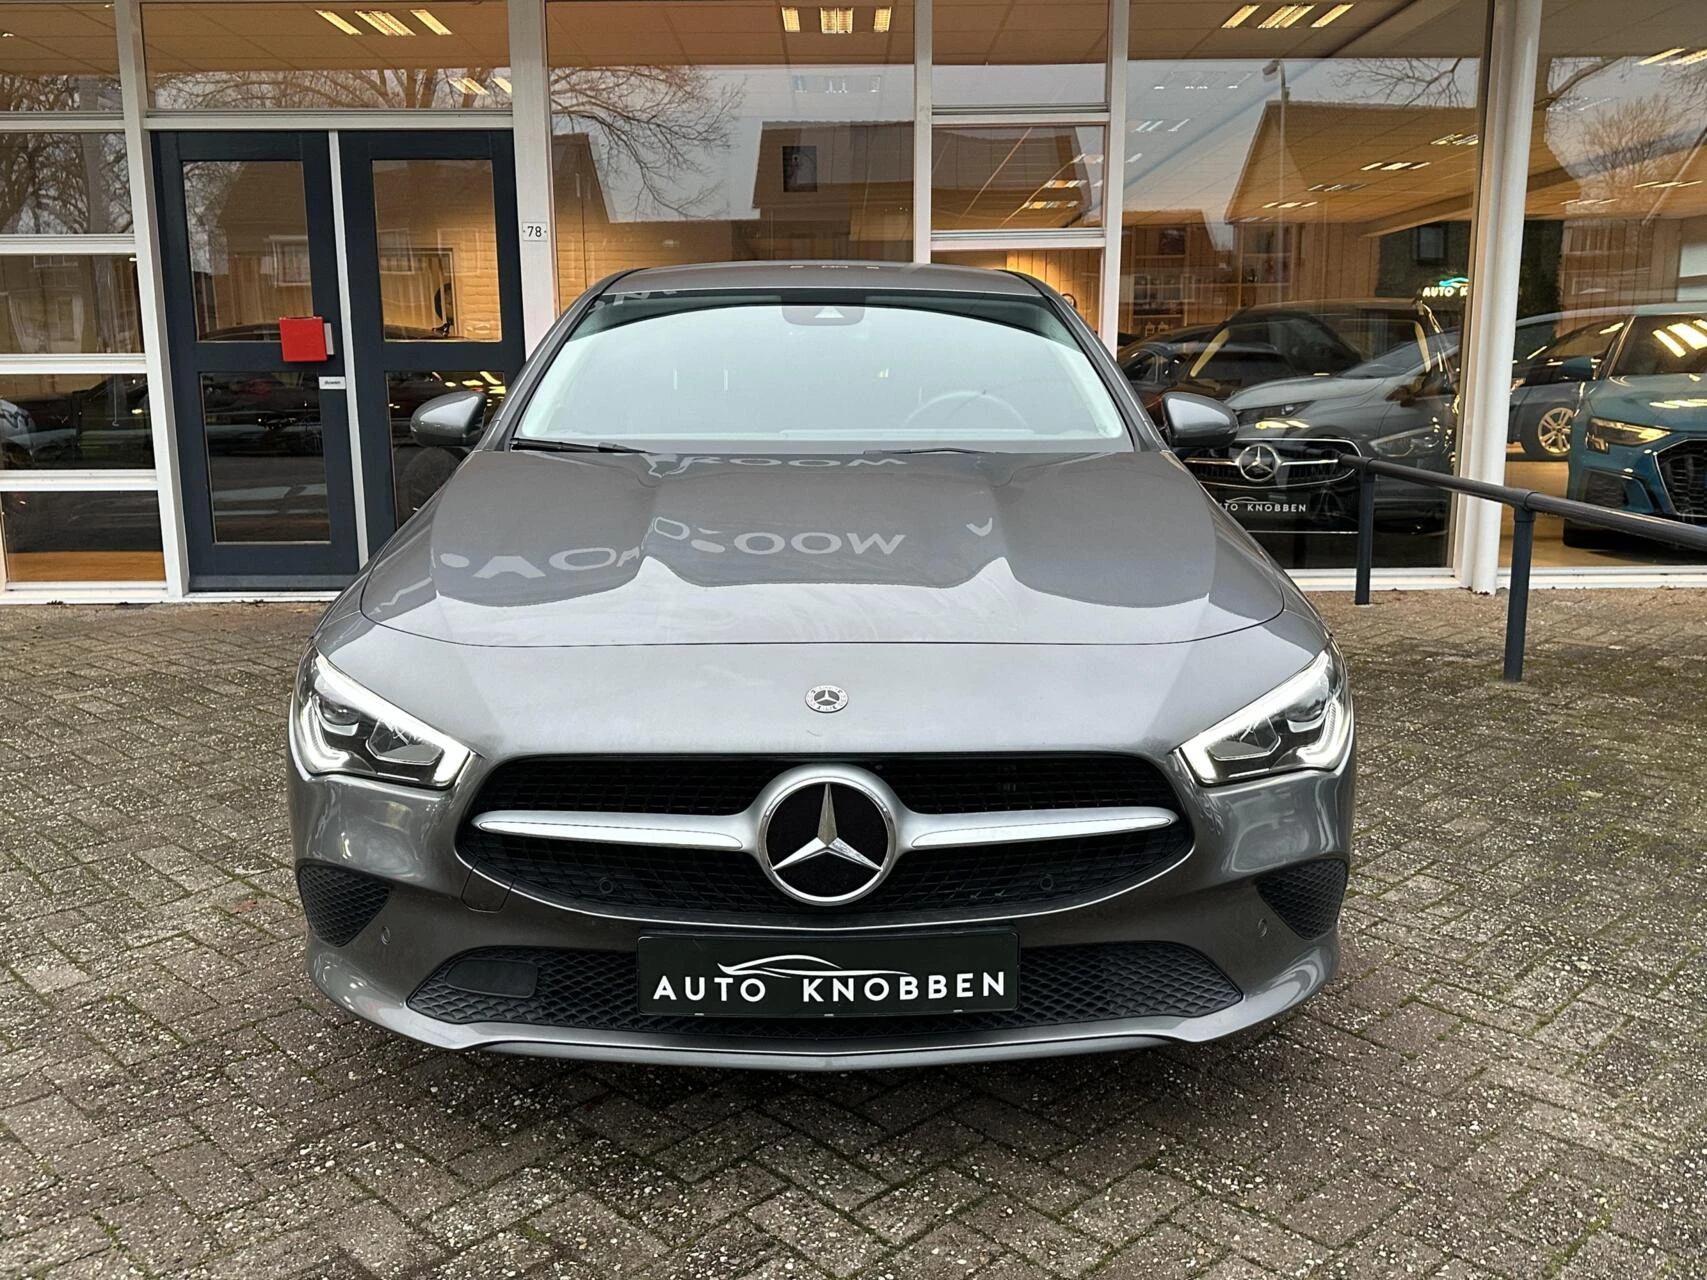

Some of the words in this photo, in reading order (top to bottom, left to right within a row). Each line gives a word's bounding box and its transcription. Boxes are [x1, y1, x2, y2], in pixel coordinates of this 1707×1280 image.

[527, 225, 542, 238] 78
[1422, 286, 1455, 298] AUTO
[1247, 503, 1307, 513] KNOBBEN
[652, 974, 767, 1003] AUTO
[802, 971, 1006, 1003] KNOBBEN
